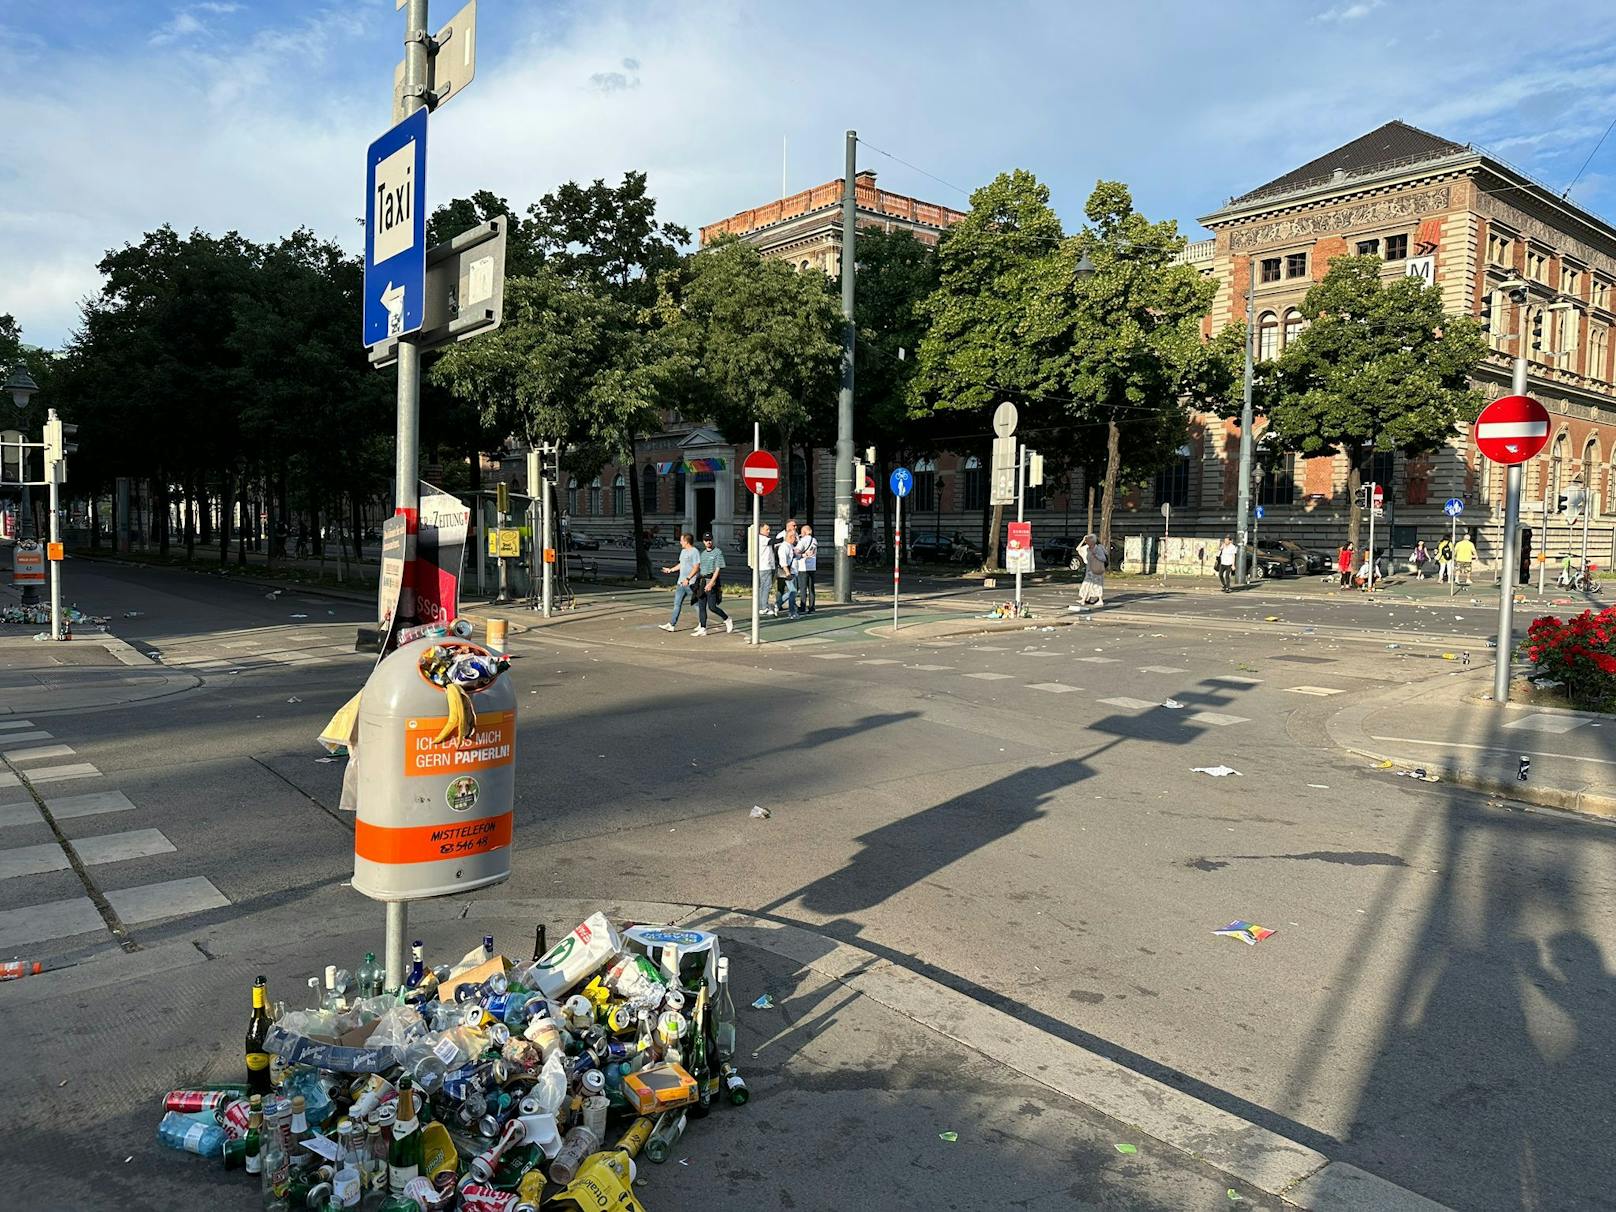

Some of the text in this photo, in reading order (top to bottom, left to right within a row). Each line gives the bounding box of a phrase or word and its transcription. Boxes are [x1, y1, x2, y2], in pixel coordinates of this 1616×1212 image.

[377, 166, 410, 234] Taxi
[1410, 261, 1430, 278] M
[433, 511, 464, 529] ZEITUNG
[416, 735, 438, 750] ICH
[475, 730, 502, 745] MICH
[416, 744, 510, 768] GERN PAPIERLN!
[430, 821, 496, 842] MISTTELEFON
[456, 837, 489, 852] 546 48
